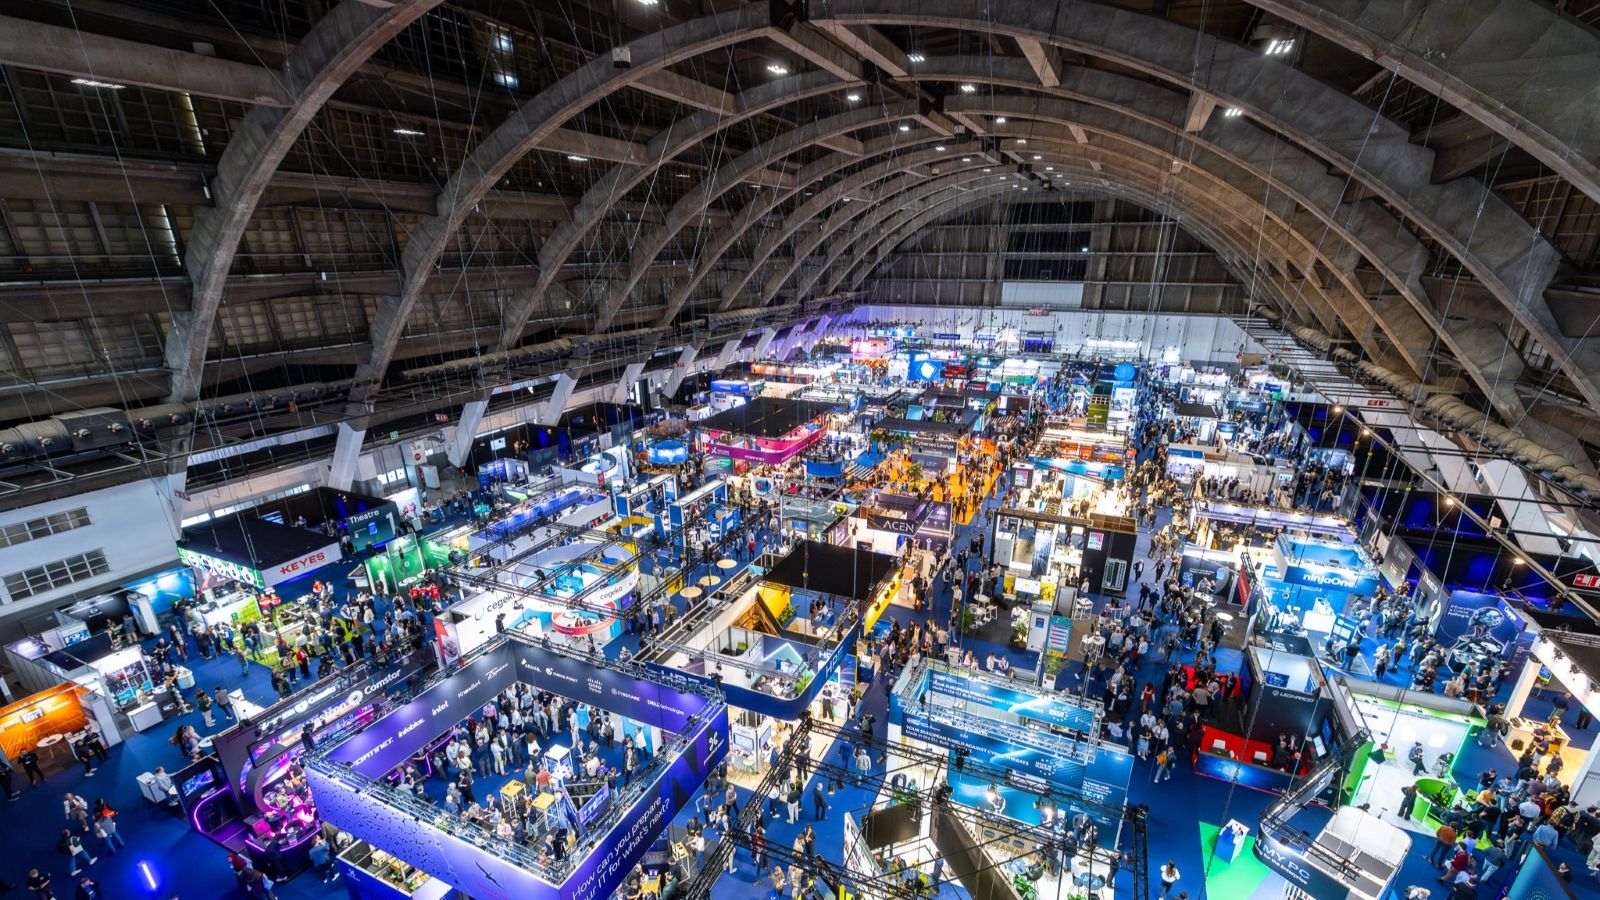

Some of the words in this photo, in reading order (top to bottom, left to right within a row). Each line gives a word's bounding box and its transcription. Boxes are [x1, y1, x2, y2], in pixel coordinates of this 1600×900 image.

[349, 510, 379, 524] Theatre
[386, 512, 396, 535] 1
[883, 520, 914, 533] ACEN
[280, 552, 325, 574] KEYES
[1303, 574, 1356, 588] ninjaOne
[486, 592, 516, 612] cegek
[600, 586, 623, 600] cegeka
[825, 646, 844, 677] HPE
[364, 669, 401, 695] Comstor
[432, 700, 449, 716] intel
[572, 871, 595, 900] How
[596, 851, 614, 874] can
[614, 833, 631, 855] you
[631, 796, 661, 835] prepare
[598, 870, 607, 888] IT
[609, 855, 622, 877] for
[622, 825, 649, 859] what's
[649, 797, 670, 829] next?
[1263, 844, 1286, 861] MY
[1288, 861, 1310, 880] PC
